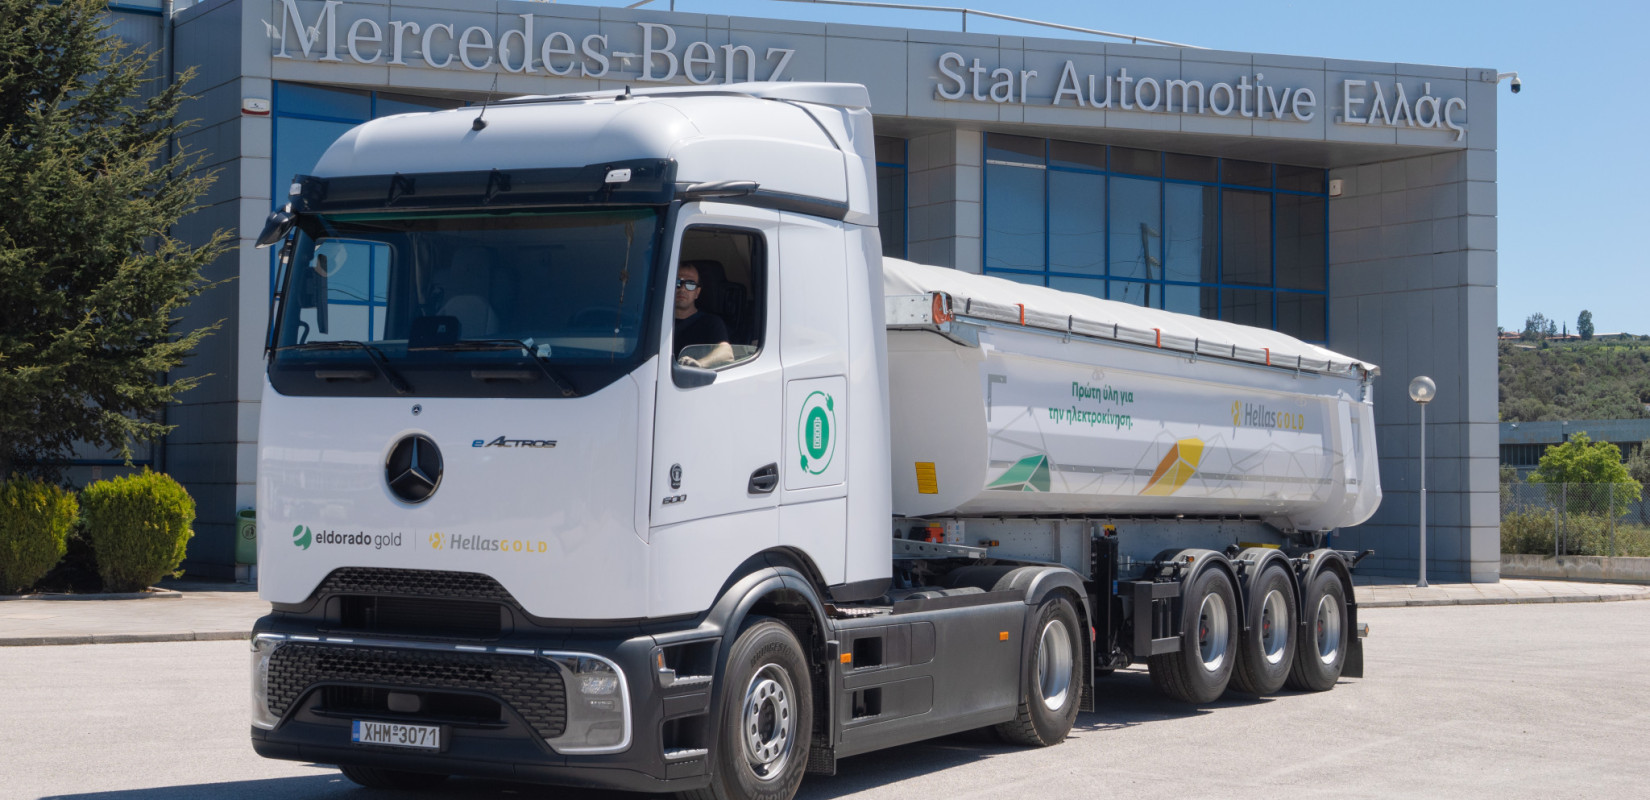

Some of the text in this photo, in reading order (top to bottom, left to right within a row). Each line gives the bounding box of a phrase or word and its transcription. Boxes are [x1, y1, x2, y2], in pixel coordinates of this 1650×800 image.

[273, 0, 796, 84] Mercedes-Benz
[936, 51, 1467, 141] Star Automotive Ελλάς
[1072, 381, 1134, 406] Πρώτη ύλη για
[1048, 406, 1133, 430] την ηλεκτροκίνηση.
[662, 494, 687, 505] 600
[315, 530, 402, 549] eldorado gold
